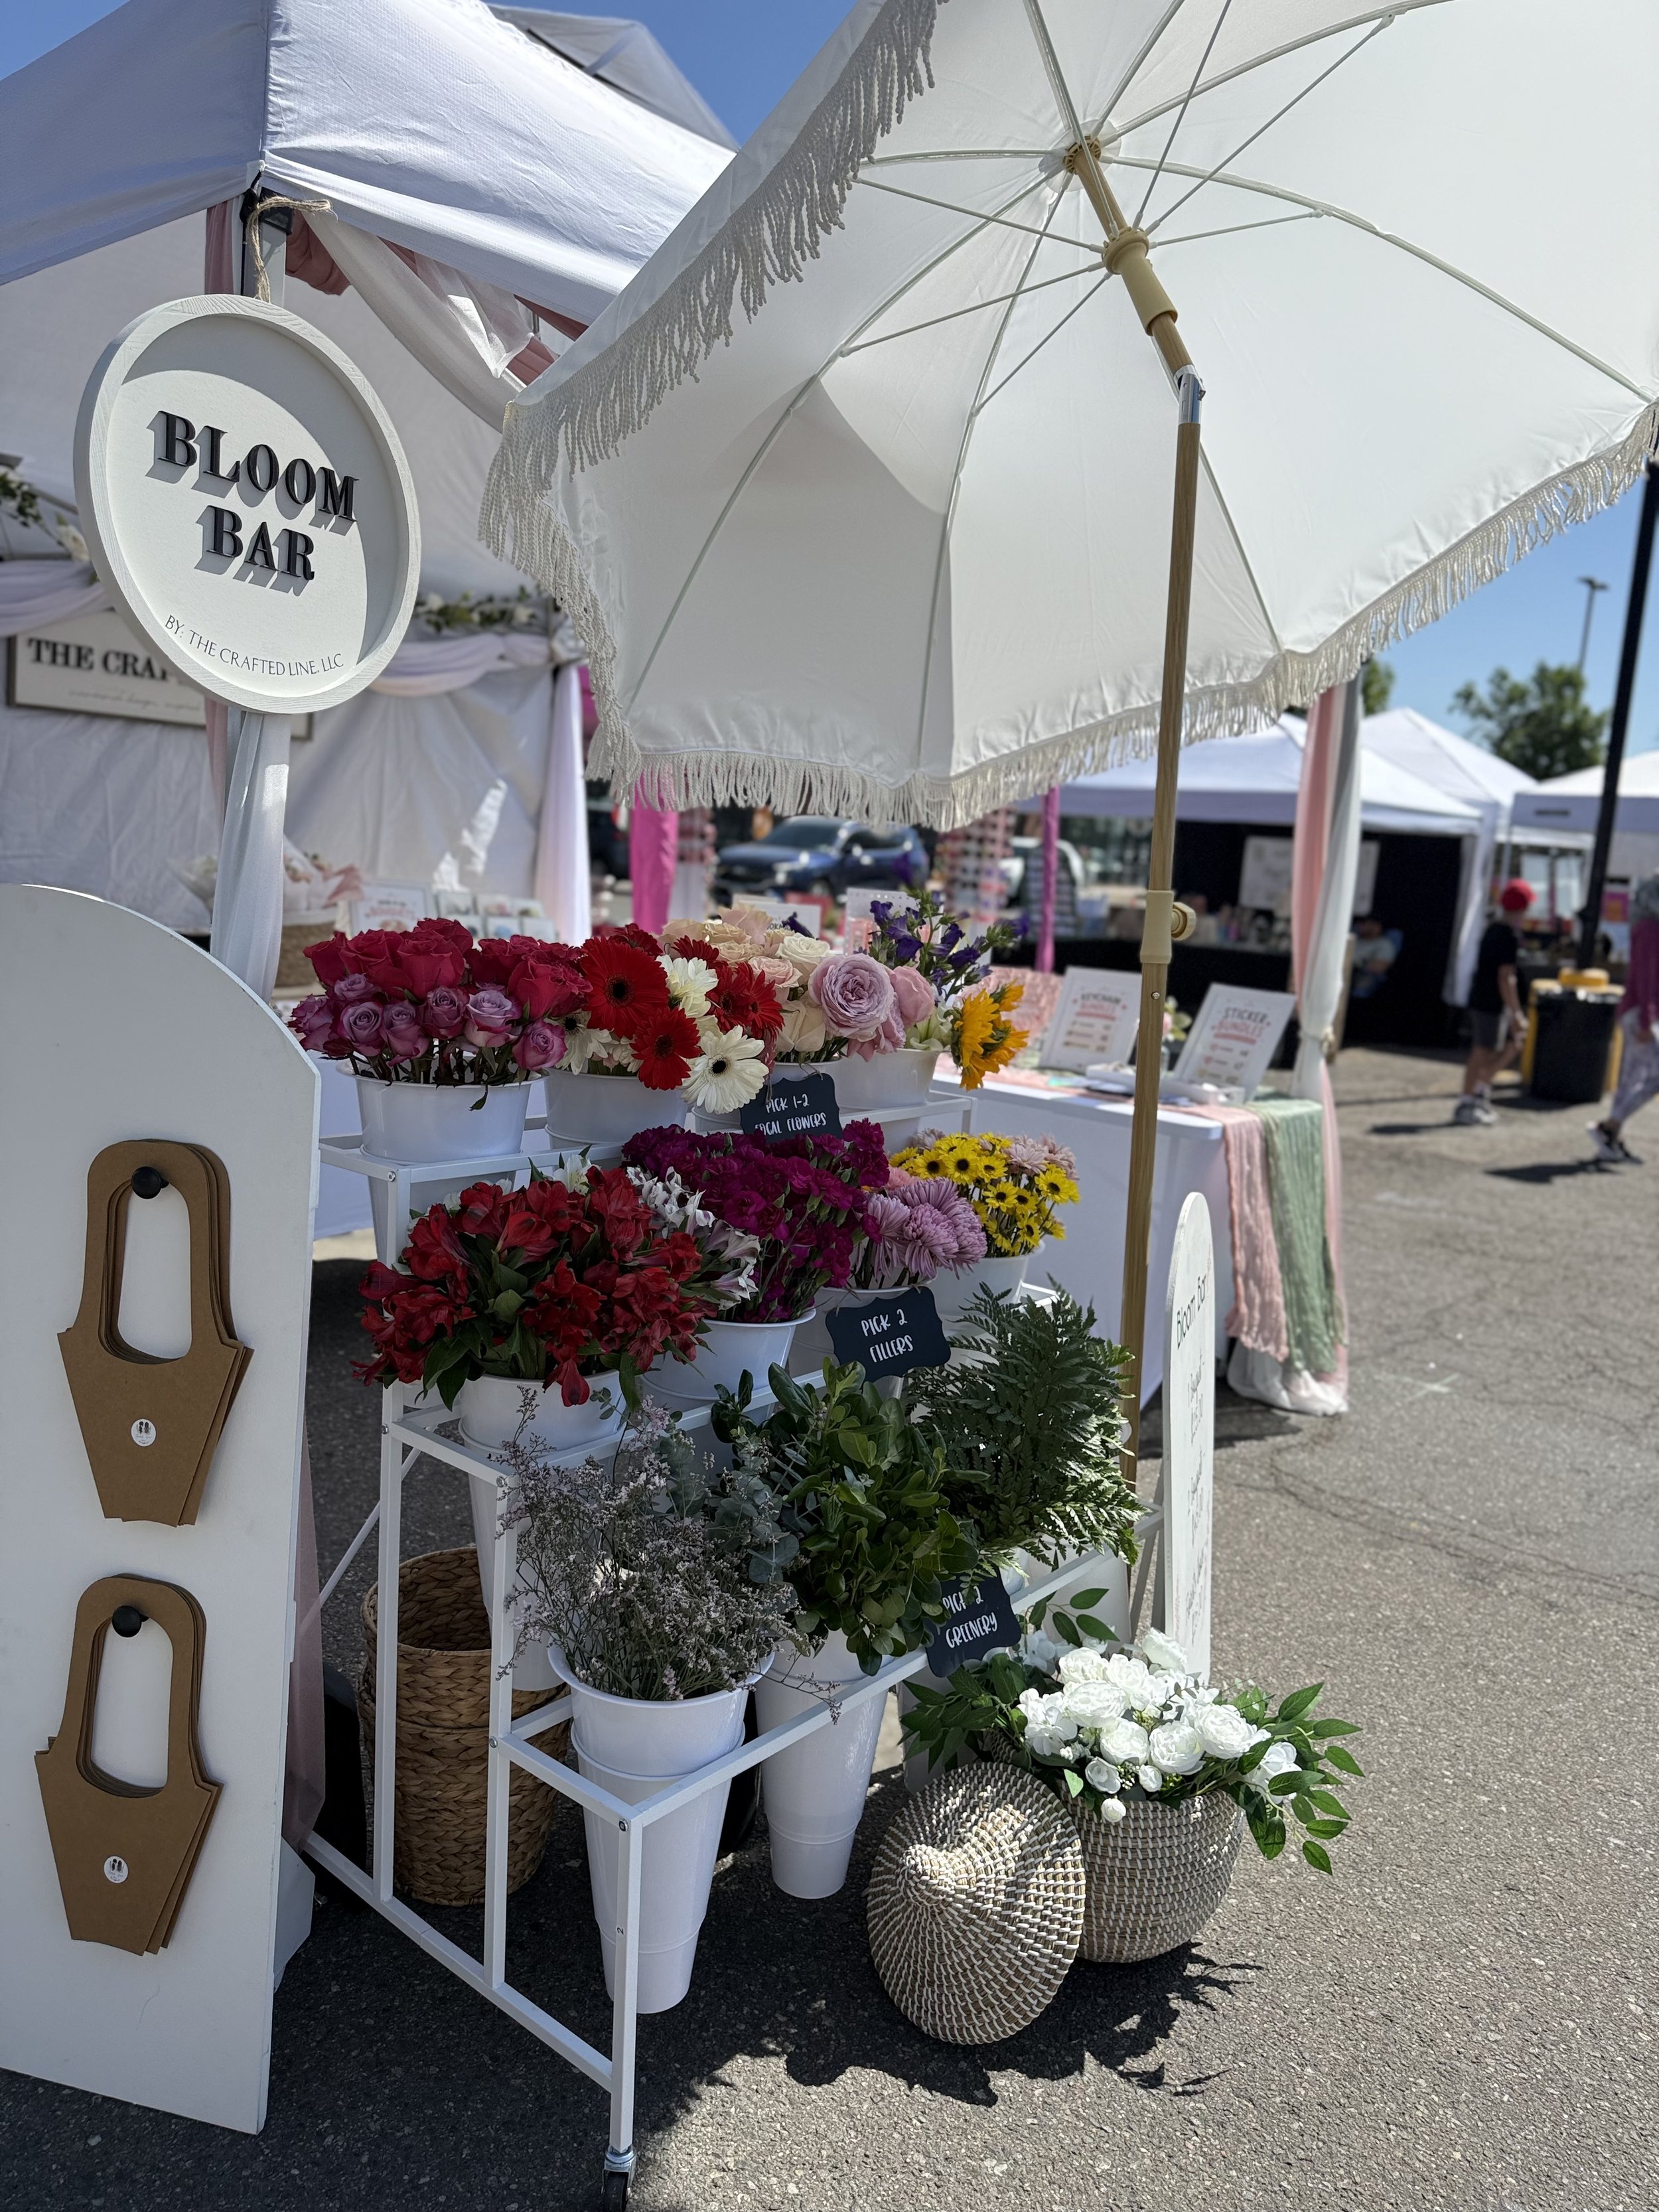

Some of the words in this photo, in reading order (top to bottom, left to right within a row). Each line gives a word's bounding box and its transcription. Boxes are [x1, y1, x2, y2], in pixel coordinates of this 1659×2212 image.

[157, 410, 360, 522] BLOOM
[206, 505, 315, 580] BAR
[28, 637, 94, 672] THE
[165, 615, 184, 638] BY:
[188, 629, 217, 658] THE
[219, 648, 285, 676] CRAFTED
[321, 653, 344, 673] LLC
[1222, 1007, 1268, 1024] STICKER
[766, 1098, 788, 1114] PICK
[792, 1094, 810, 1109] 1-2
[786, 1112, 827, 1132] FLOWERS
[861, 1314, 891, 1337] PICK
[897, 1308, 908, 1326] 2
[1177, 1294, 1196, 1350] Bloom
[869, 1335, 914, 1363] FILLERS
[973, 1585, 984, 1605] 2
[945, 1611, 998, 1649] GREENERY
[616, 1927, 624, 1935] 2
